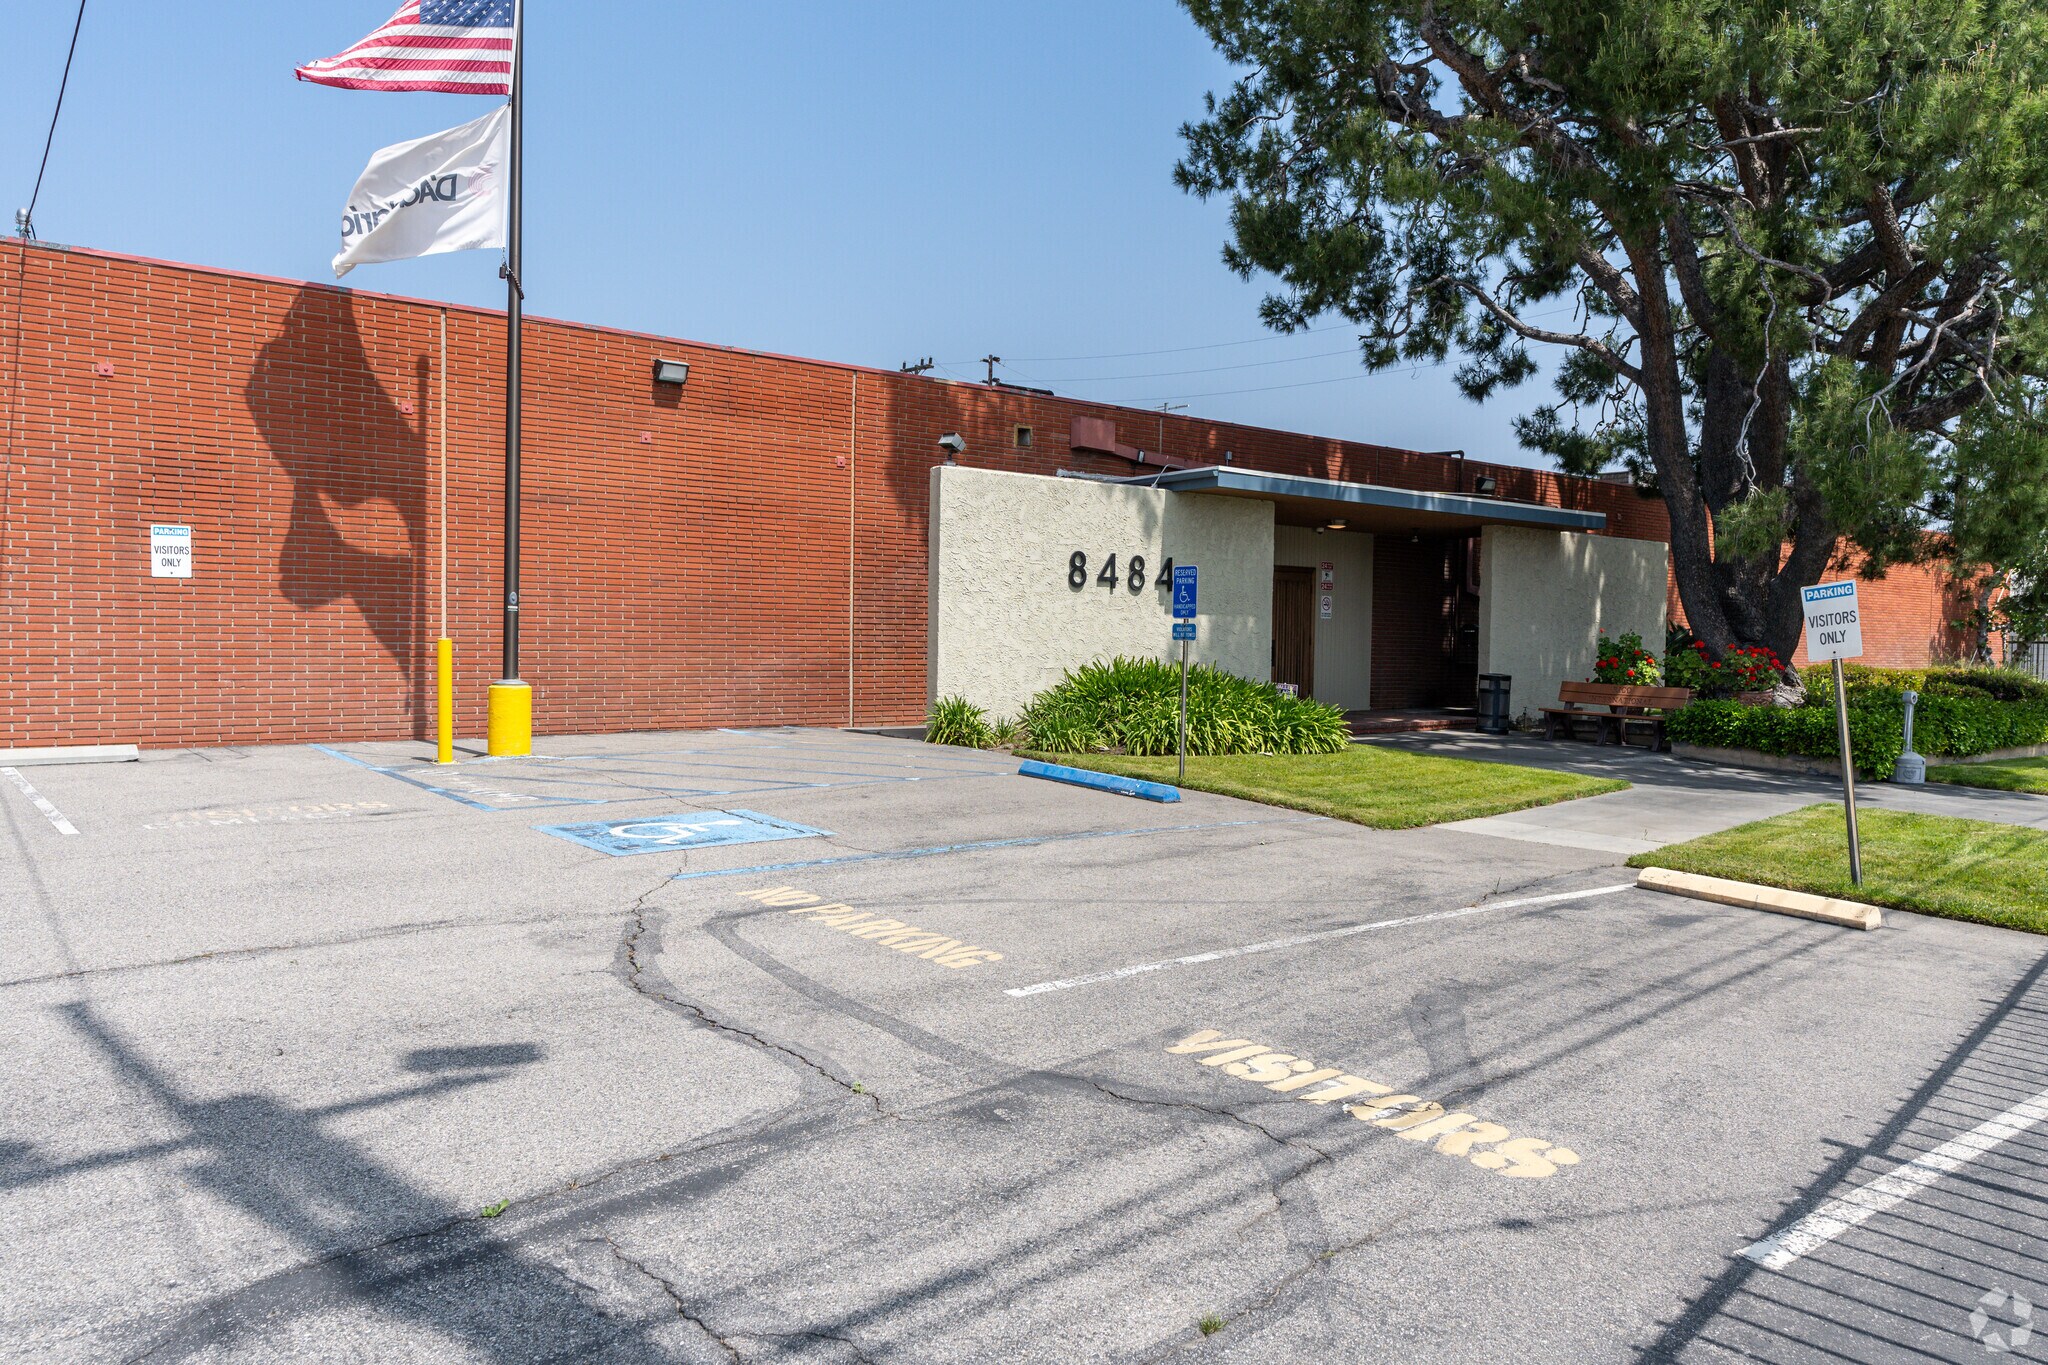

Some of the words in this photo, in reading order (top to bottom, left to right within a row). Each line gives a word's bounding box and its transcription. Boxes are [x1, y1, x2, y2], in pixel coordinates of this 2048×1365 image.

[154, 527, 188, 536] PARKING
[154, 545, 190, 555] VISITORS
[161, 557, 182, 567] ONLY
[1068, 550, 1173, 592] 8484
[1174, 568, 1196, 577] RESERVED
[1176, 577, 1195, 585] PARKING
[1806, 585, 1853, 600] PARKING
[1808, 610, 1857, 629] VISITORS
[1819, 630, 1847, 645] ONLY
[735, 885, 821, 906] NO
[787, 903, 1004, 969] PARKING
[1164, 1028, 1580, 1178] VISITORS
